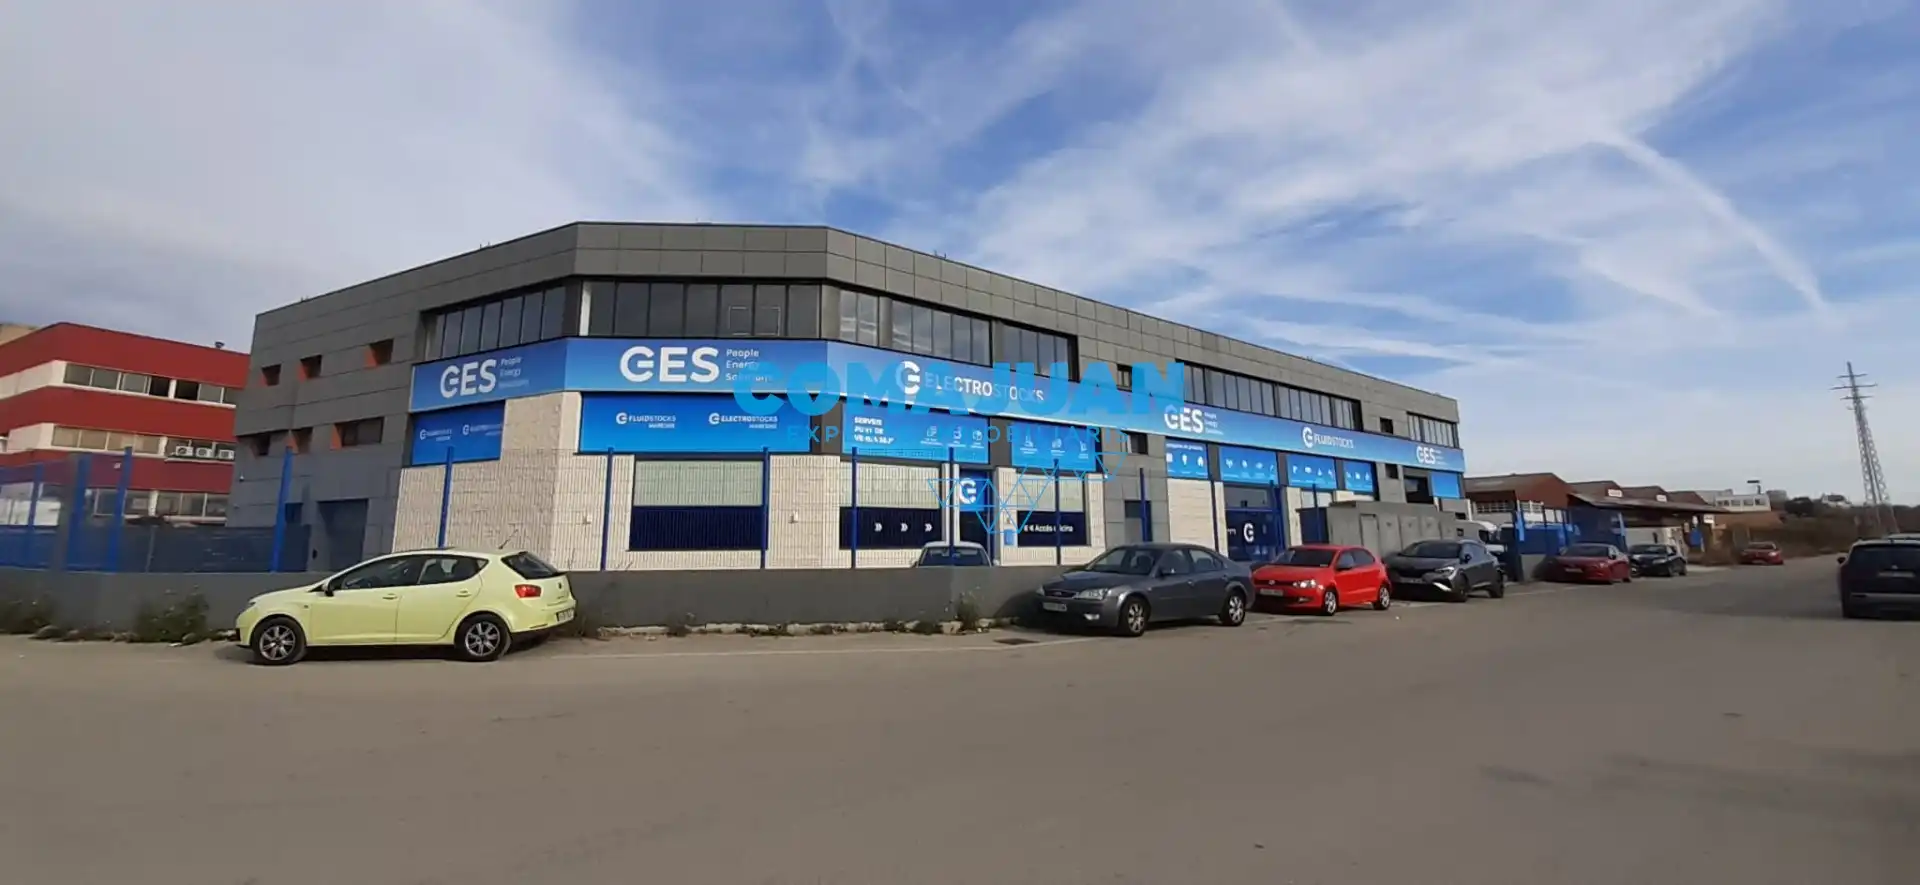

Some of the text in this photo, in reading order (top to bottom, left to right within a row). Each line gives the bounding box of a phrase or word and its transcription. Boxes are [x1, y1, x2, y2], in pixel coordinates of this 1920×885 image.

[619, 345, 720, 383] GES
[726, 348, 760, 359] People
[440, 359, 497, 398] GES
[1163, 403, 1204, 434] GES
[1416, 446, 1436, 465] GES
